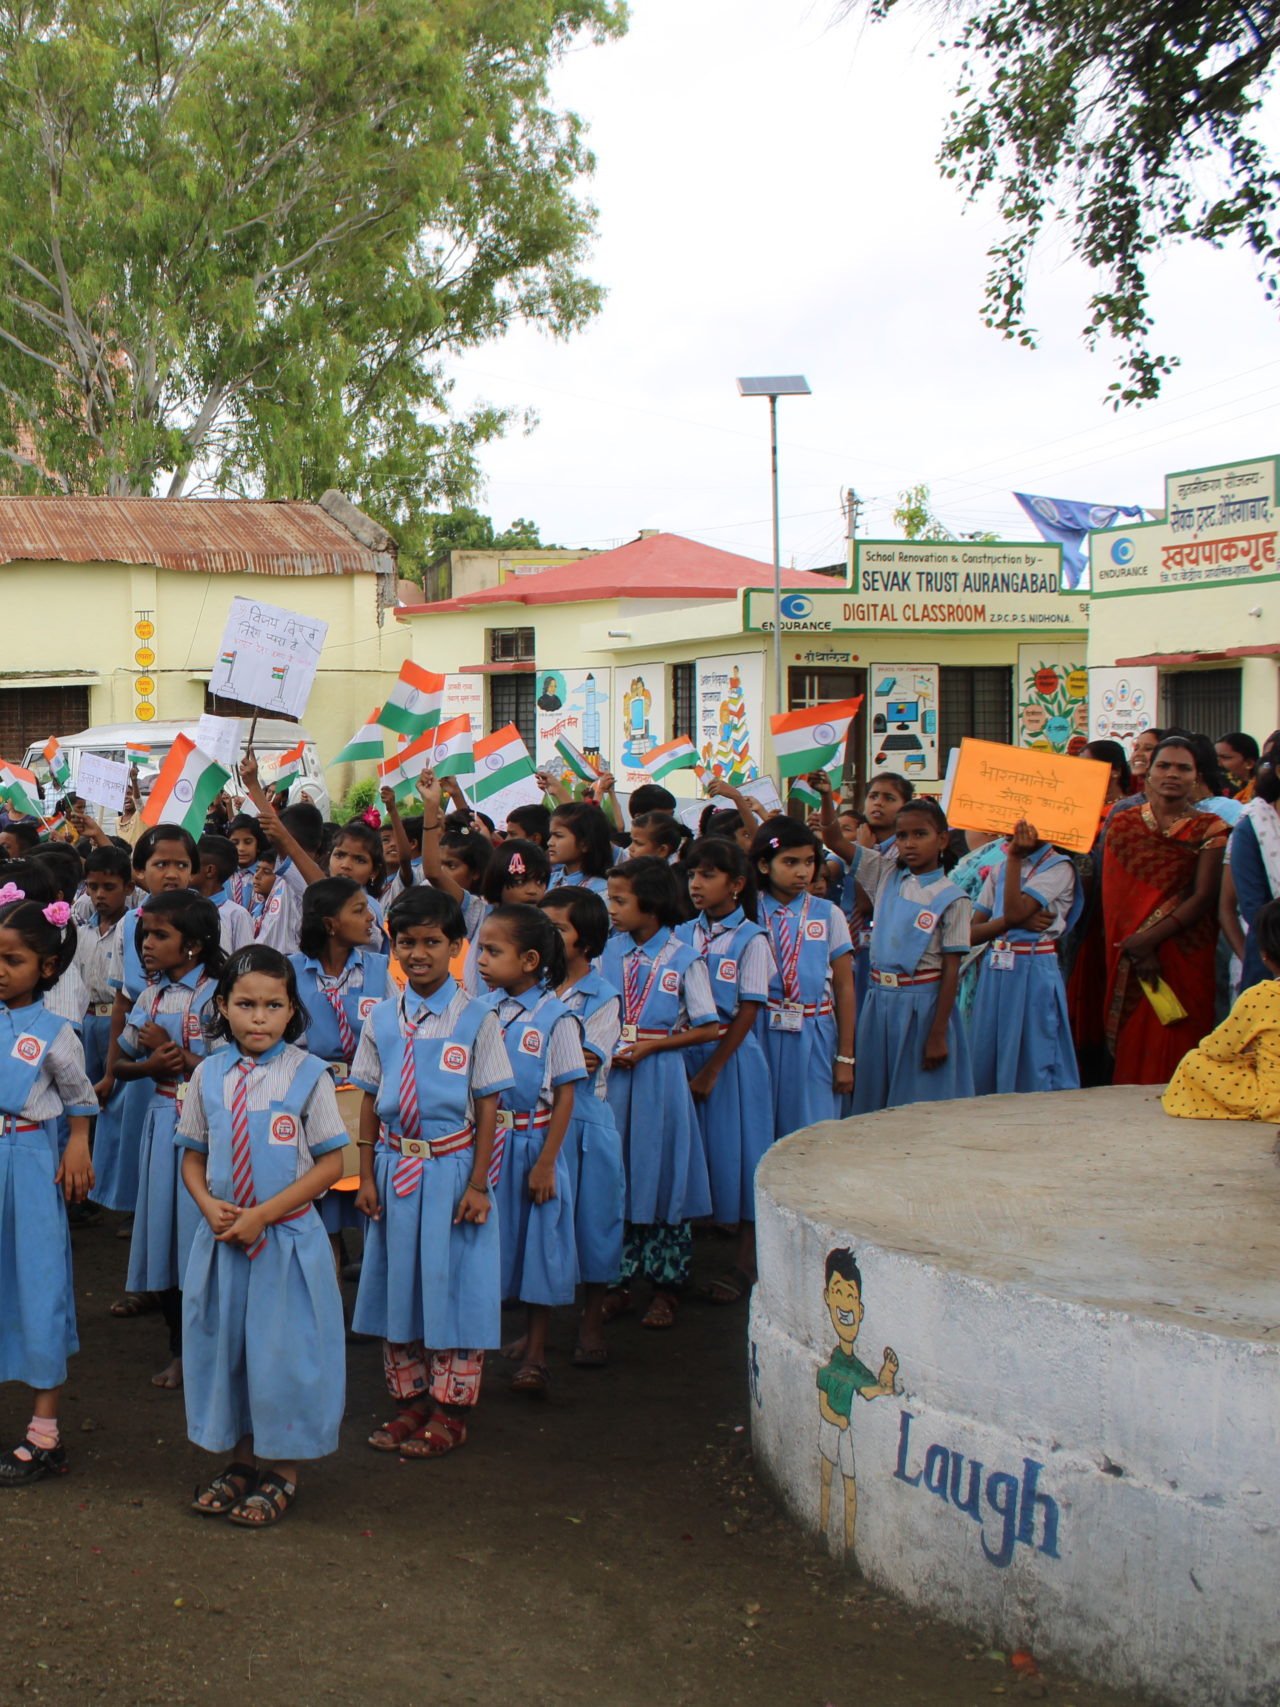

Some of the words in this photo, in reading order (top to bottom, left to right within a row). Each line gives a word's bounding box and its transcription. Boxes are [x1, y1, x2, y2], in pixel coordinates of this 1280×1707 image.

[865, 551, 895, 562] School
[898, 552, 948, 563] Renovation
[952, 554, 959, 562] &
[1161, 531, 1279, 571] स्वयंपाकगृह
[862, 570, 912, 592] SEVAK
[916, 571, 959, 592] TRUST
[1098, 566, 1149, 580] ENDURANCE
[843, 603, 900, 622] DIGITAL
[902, 603, 986, 622] CLASSROOM
[761, 621, 832, 630] ENDURANCE
[893, 1410, 1061, 1568] Laugh
